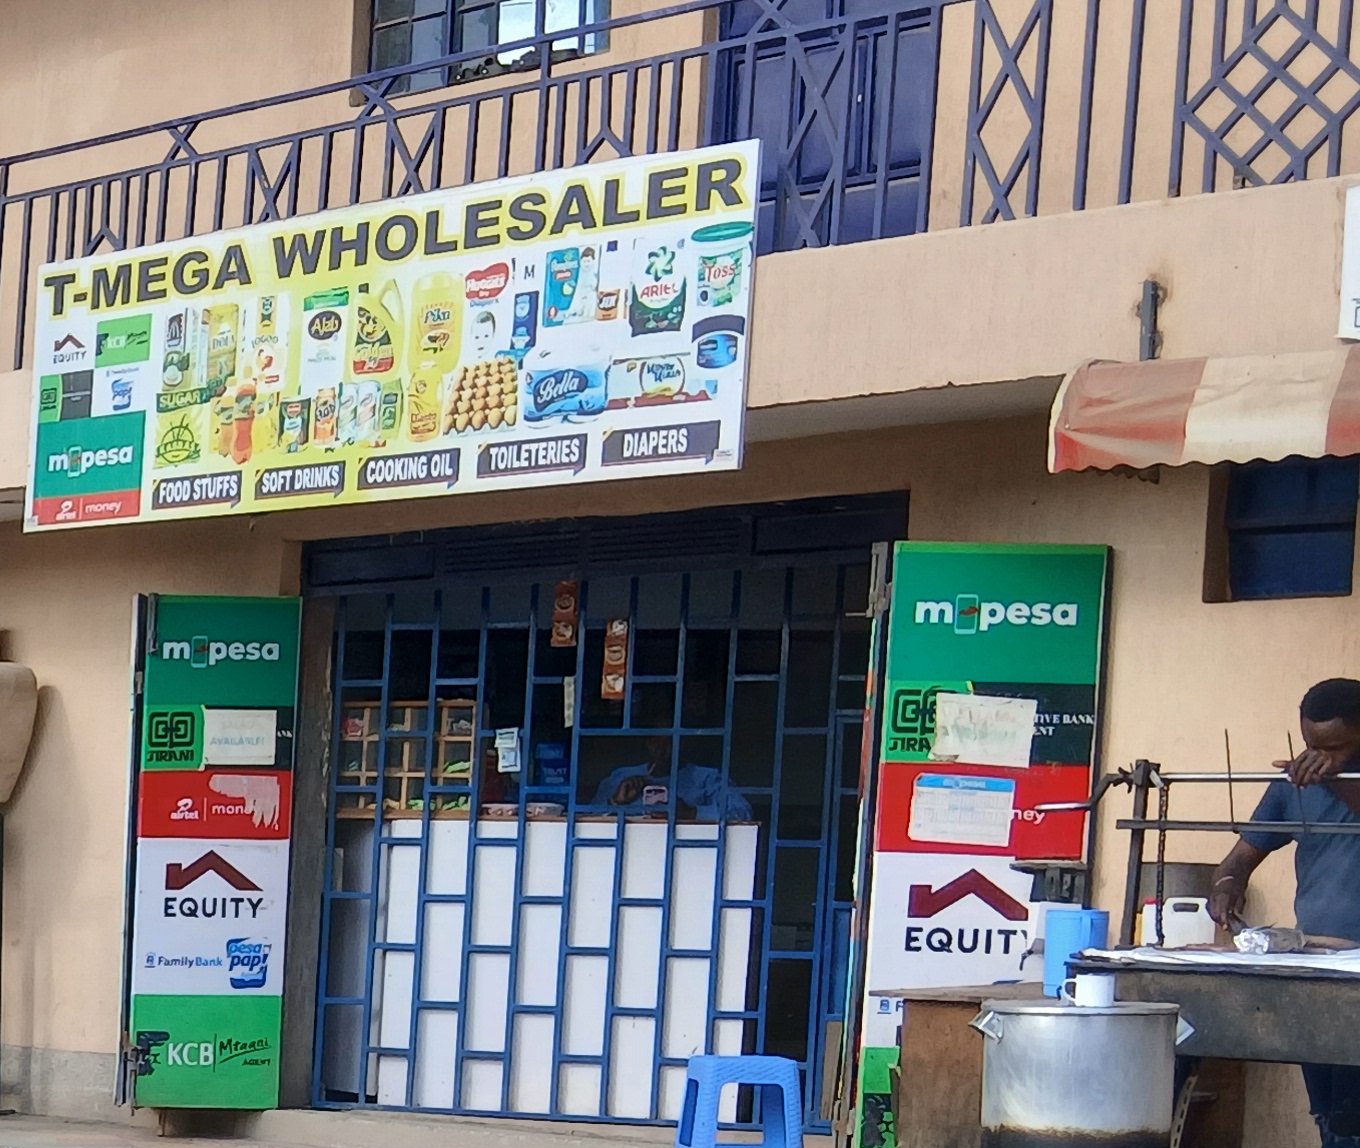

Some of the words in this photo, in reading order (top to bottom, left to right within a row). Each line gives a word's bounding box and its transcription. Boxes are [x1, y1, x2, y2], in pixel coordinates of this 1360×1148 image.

[44, 244, 252, 313] T-MEGA
[271, 157, 745, 280] WHOLESALER
[639, 281, 680, 299] ARIEL
[53, 350, 87, 364] EQUITY
[159, 391, 201, 408] SUGAR
[537, 374, 580, 404] Bella
[489, 438, 580, 471] TOILETERIES
[622, 428, 688, 458] DIAPERS
[261, 471, 292, 493] SOFT
[294, 464, 340, 489] DRINKS
[366, 457, 428, 484] COOKING
[431, 453, 453, 477] OIL
[158, 480, 191, 504] FOOD
[192, 475, 239, 500] STUFFS
[1062, 714, 1095, 725] BANK
[1012, 809, 1046, 825] ney
[163, 896, 264, 919] EQUITY
[167, 1041, 214, 1067] KCB
